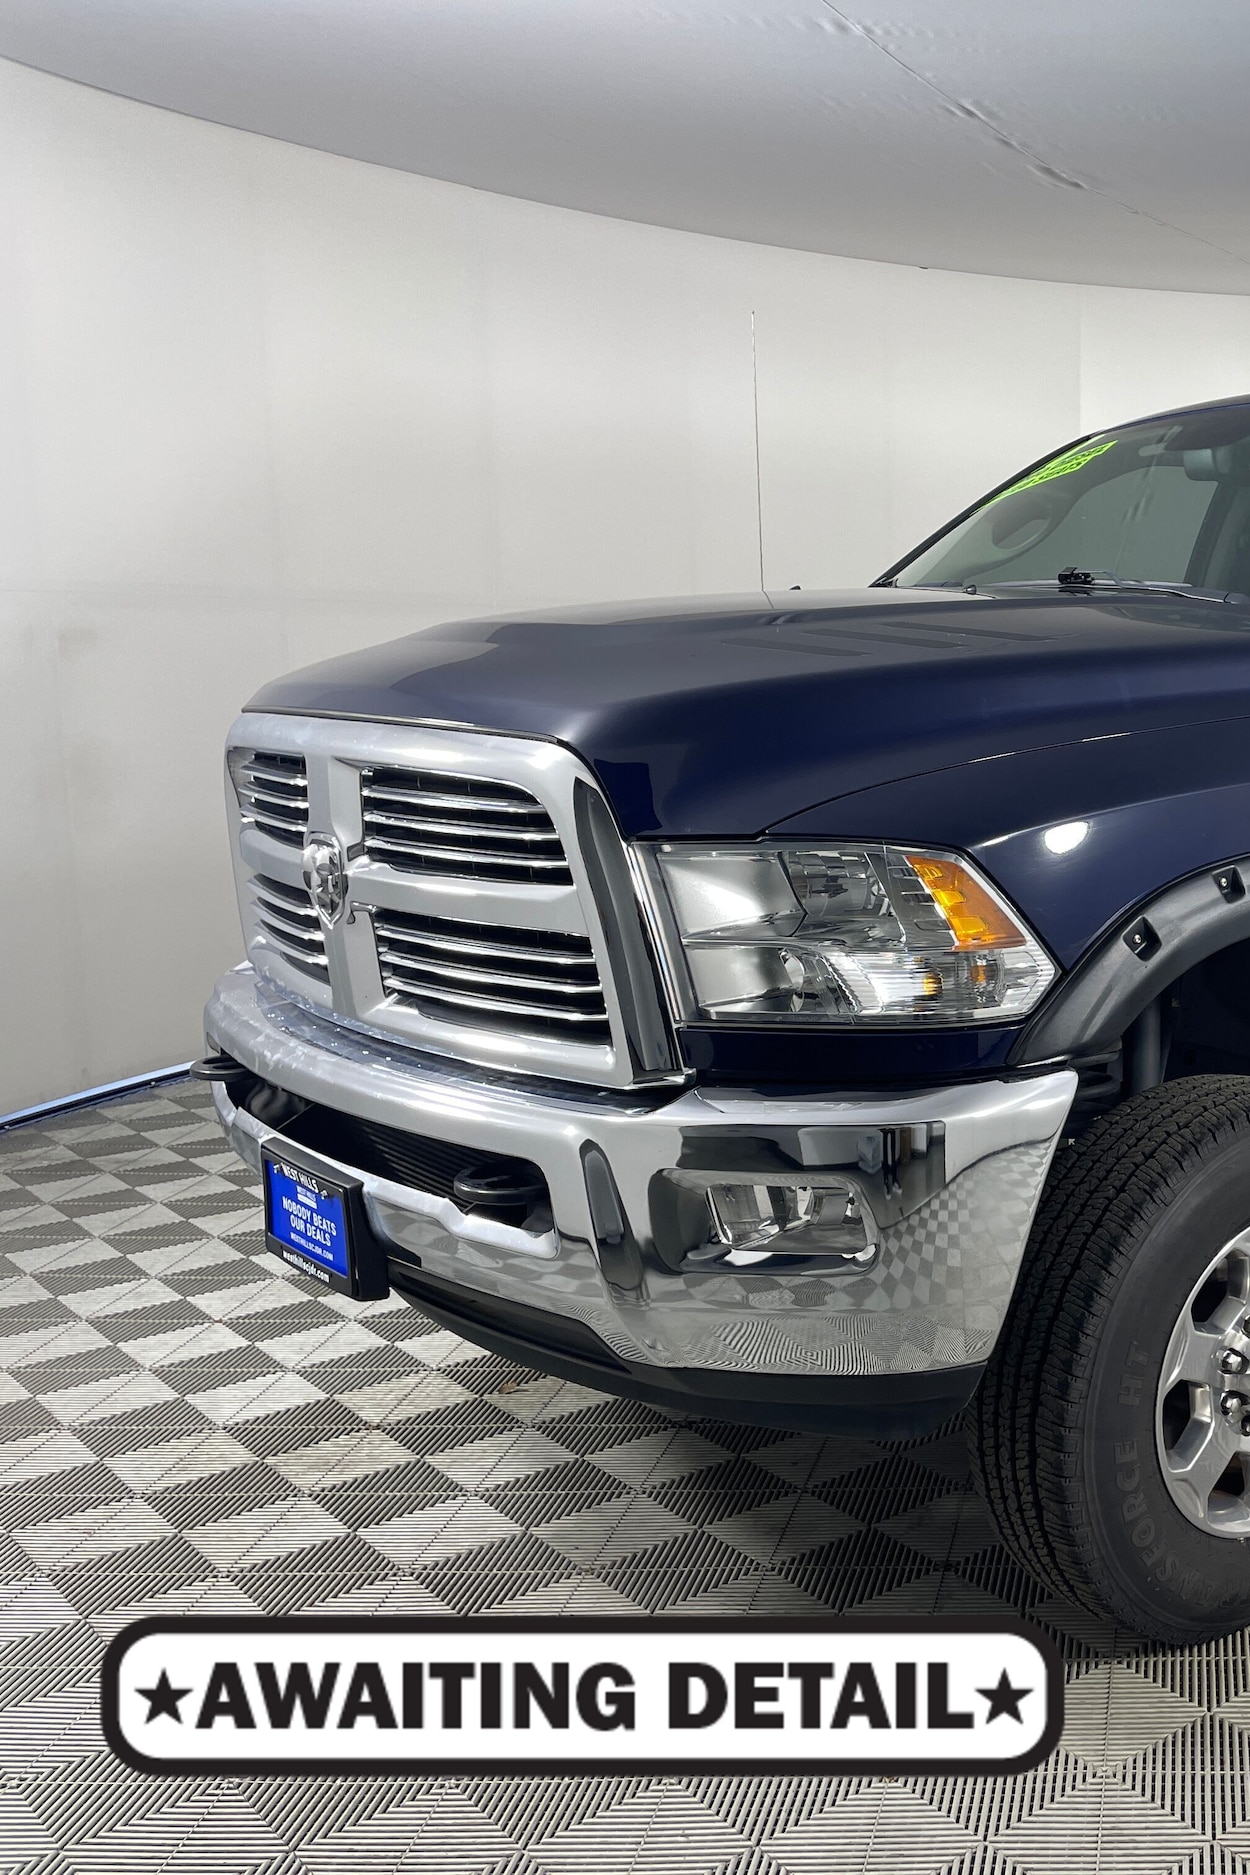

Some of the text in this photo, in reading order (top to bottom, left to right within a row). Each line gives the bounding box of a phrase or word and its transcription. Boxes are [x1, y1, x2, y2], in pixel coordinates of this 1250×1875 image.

[281, 1162, 319, 1194] WEST HILLS
[282, 1195, 312, 1222] NOBODY
[313, 1211, 337, 1237] BEATS
[290, 1214, 332, 1247] OUR DEALS
